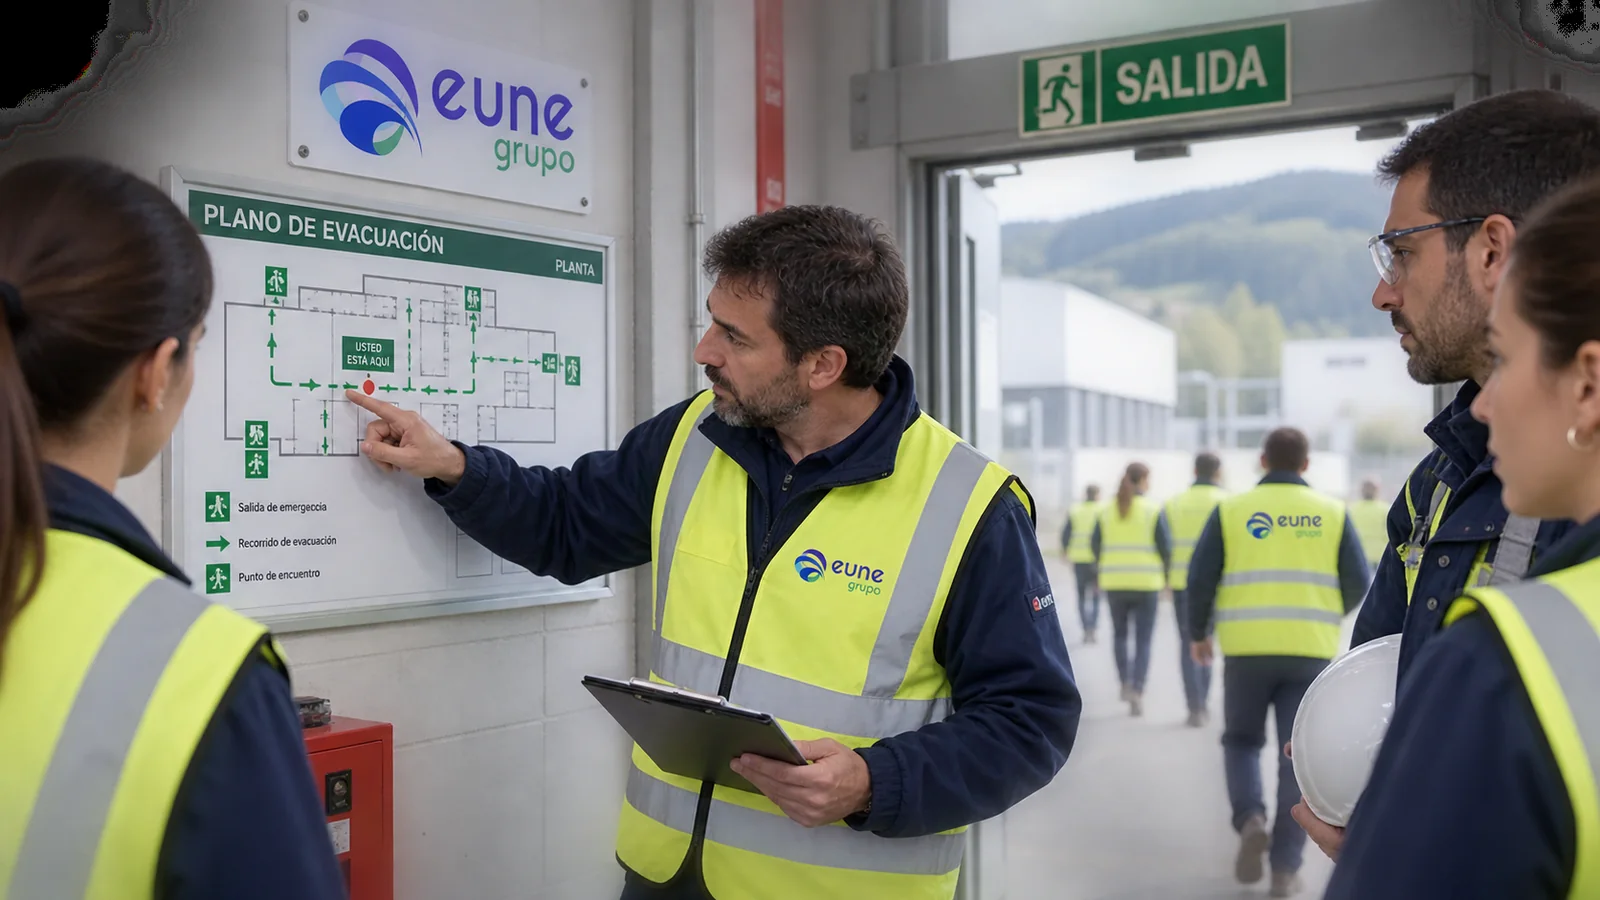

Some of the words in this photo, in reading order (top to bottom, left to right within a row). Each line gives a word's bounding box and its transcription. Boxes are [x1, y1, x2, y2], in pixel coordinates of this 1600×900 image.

[1116, 44, 1268, 105] SALIDA
[432, 69, 574, 141] eune
[494, 138, 575, 177] grupo
[204, 203, 281, 233] PLANO
[288, 215, 316, 238] DE
[323, 219, 444, 255] EVACUACIÓN
[555, 258, 595, 277] PLANTA
[355, 342, 382, 353] USTED
[238, 502, 265, 512] Salida
[266, 502, 278, 512] de
[1277, 514, 1323, 528] eune
[238, 538, 279, 548] Recorrido
[280, 537, 292, 547] de
[292, 536, 337, 546] evacuación
[238, 572, 264, 582] Punto
[265, 571, 277, 581] de
[278, 569, 321, 580] encuentro
[831, 559, 885, 583] eune
[847, 581, 881, 596] grupo
